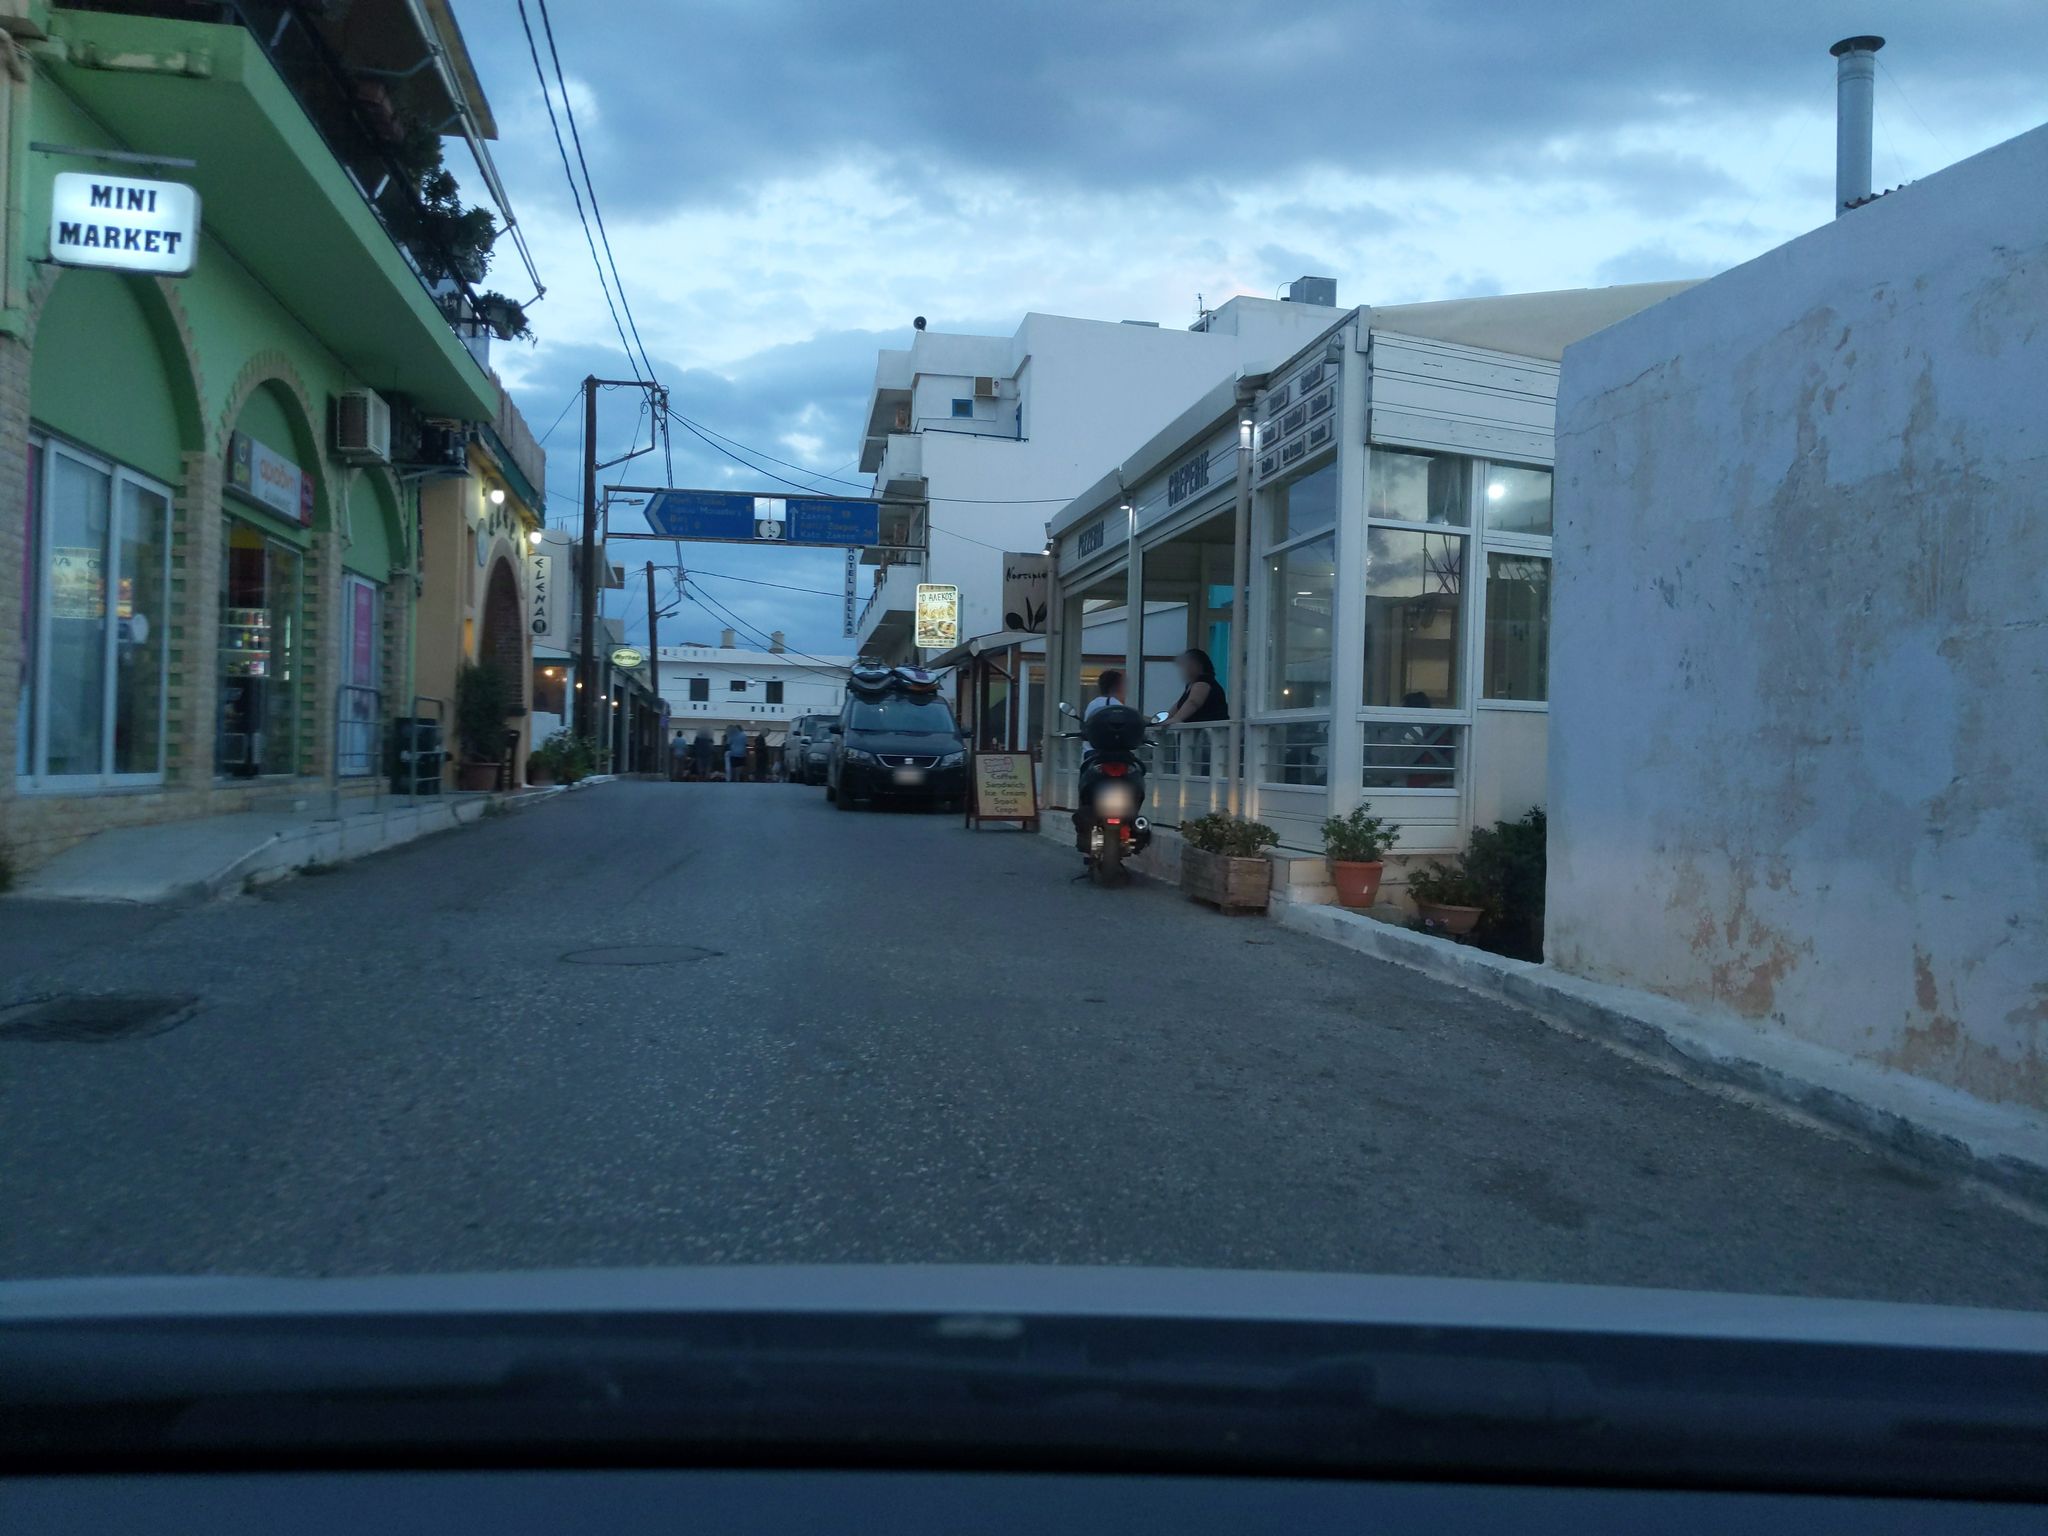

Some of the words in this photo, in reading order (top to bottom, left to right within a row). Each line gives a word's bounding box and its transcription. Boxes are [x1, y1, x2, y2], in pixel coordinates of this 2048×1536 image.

[91, 184, 157, 212] MINI
[58, 221, 181, 254] MARKET
[1168, 450, 1209, 507] CREPERIE
[847, 547, 855, 584] HOTEL
[533, 558, 547, 617] ELENA
[846, 590, 854, 635] HELLAS
[984, 781, 1025, 789] Sandwich
